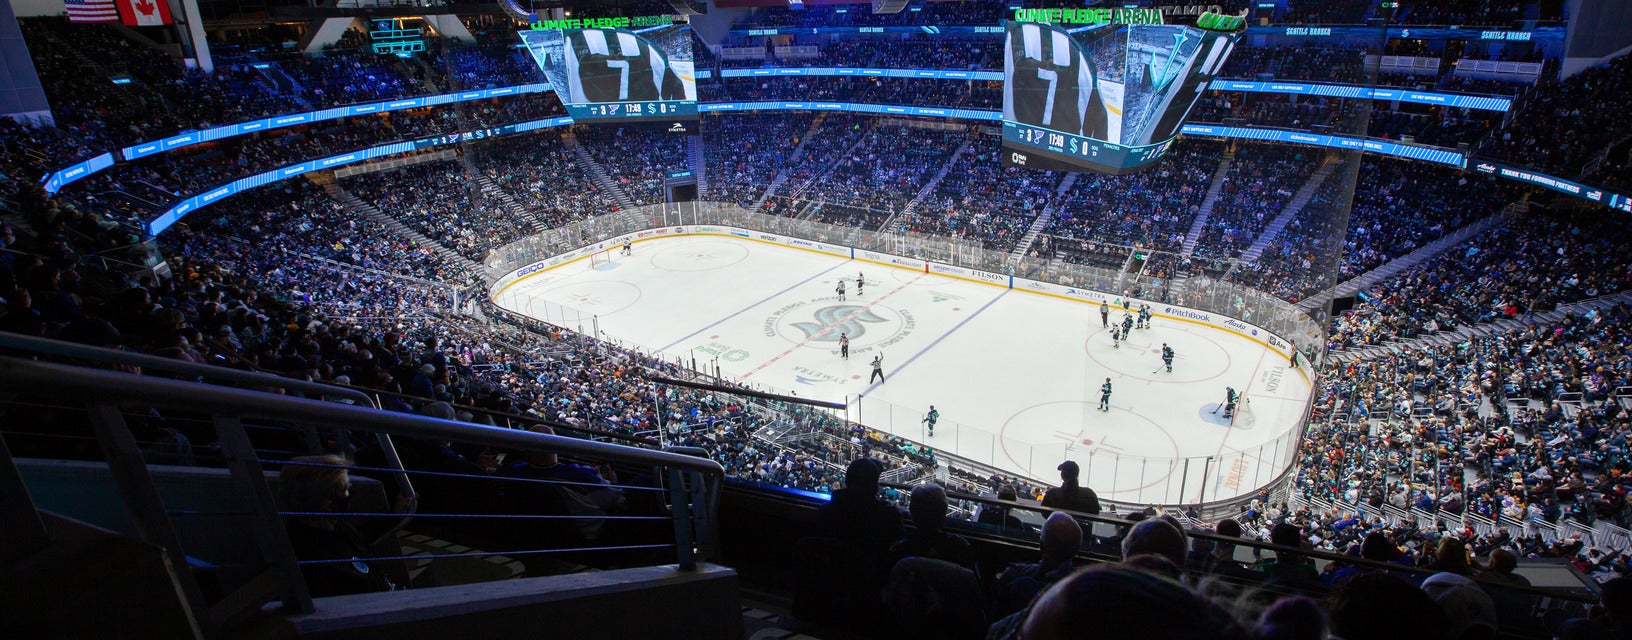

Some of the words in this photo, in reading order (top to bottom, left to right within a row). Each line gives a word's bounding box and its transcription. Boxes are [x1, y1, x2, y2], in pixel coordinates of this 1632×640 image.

[531, 19, 581, 30] CLIMATE
[583, 17, 630, 28] PLEDGE
[631, 15, 673, 26] ARENA
[1015, 8, 1060, 23] CLIMATE
[1062, 9, 1111, 24] PLEDGE
[1112, 9, 1164, 24] ARENA
[607, 60, 629, 100] 7
[1037, 67, 1058, 126] 7
[600, 105, 606, 115] 3
[660, 103, 667, 113] 0
[1026, 129, 1032, 142] 3
[1082, 141, 1088, 155] 0
[1501, 168, 1520, 179] THANK
[1520, 171, 1531, 181] YOU
[1555, 181, 1581, 193] PARTNERS
[760, 234, 777, 242] verizon
[516, 261, 545, 278] GEICO
[972, 270, 1006, 281] FILSON
[1077, 290, 1106, 299] SYMETRA
[1171, 309, 1211, 323] PitchBook
[1224, 318, 1247, 331] Alaska
[831, 346, 873, 356] AREA
[793, 365, 848, 385] SYMETRA
[1264, 365, 1285, 394] FILSON
